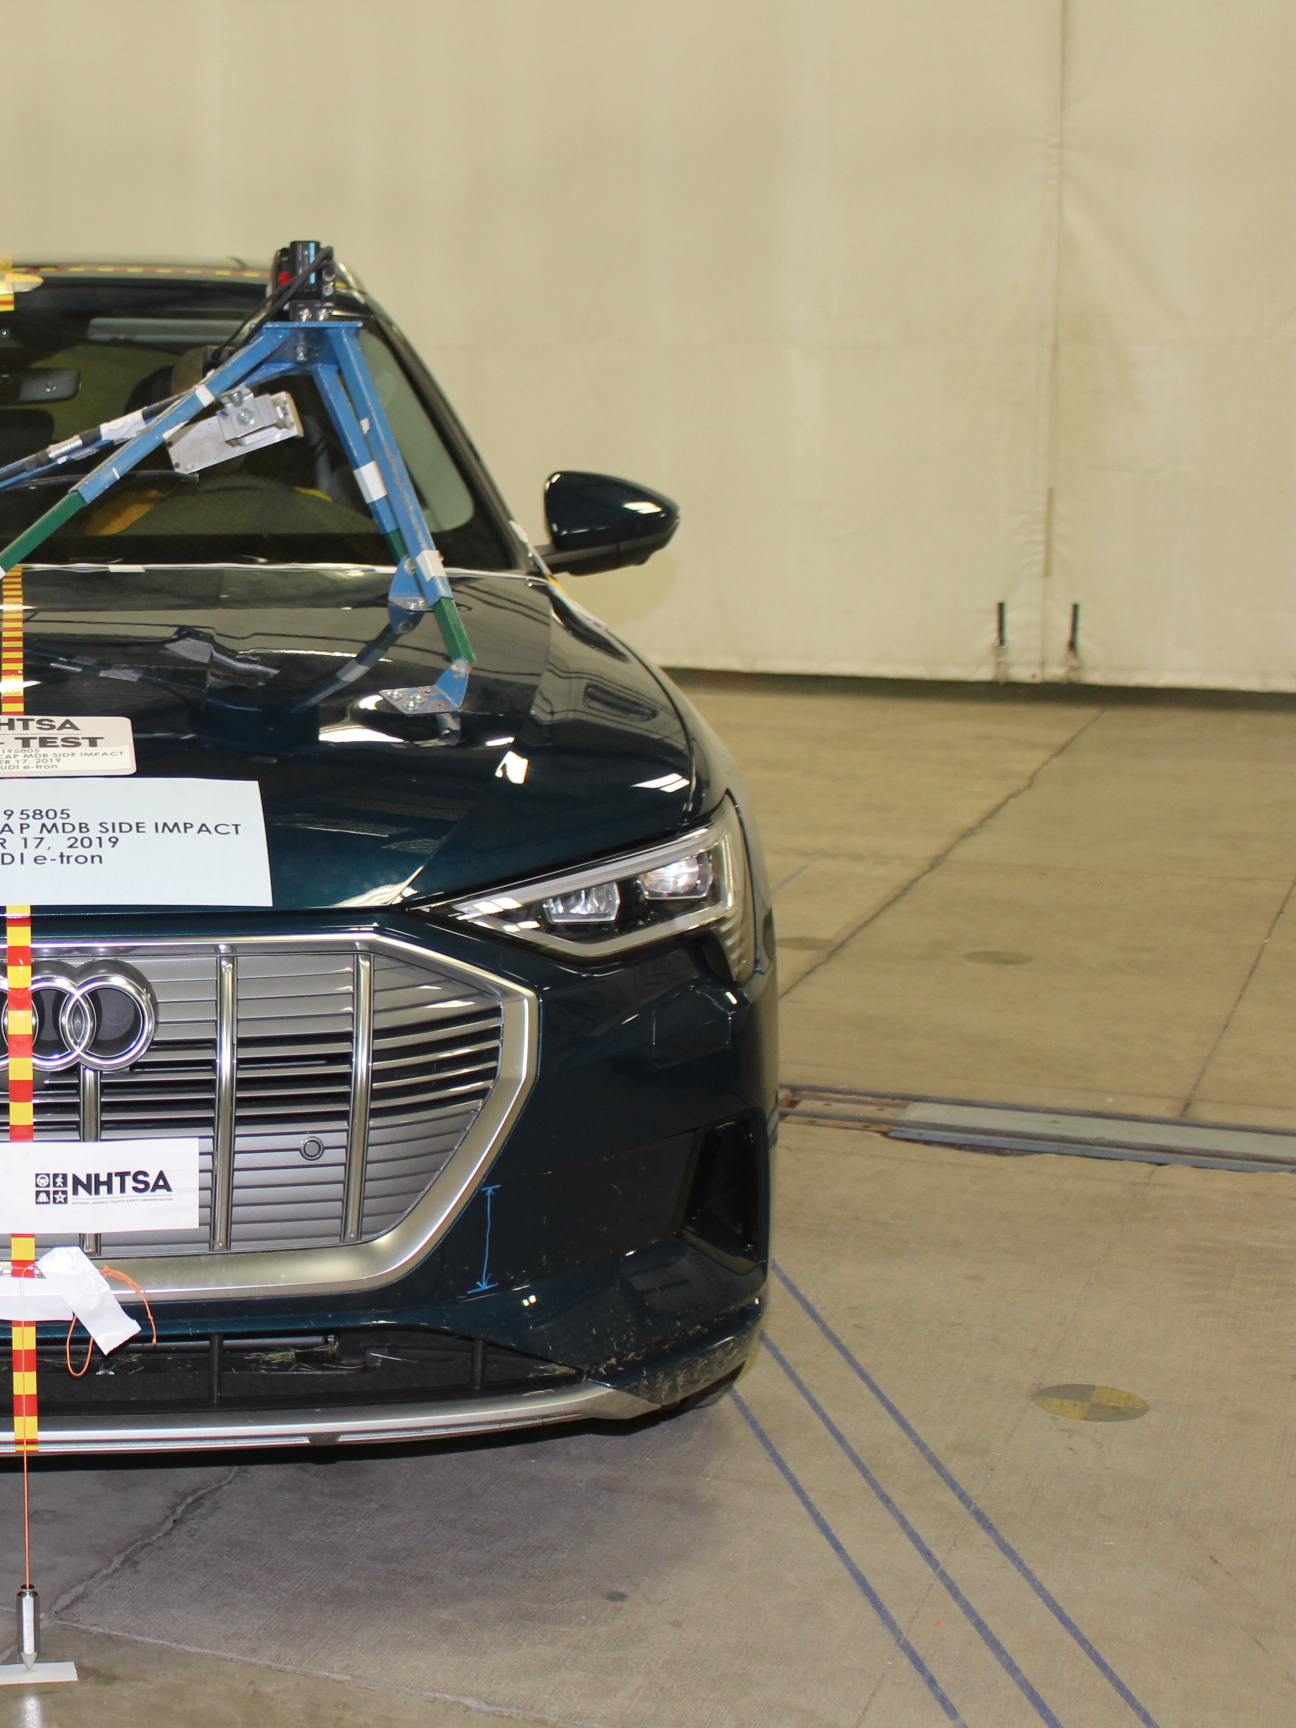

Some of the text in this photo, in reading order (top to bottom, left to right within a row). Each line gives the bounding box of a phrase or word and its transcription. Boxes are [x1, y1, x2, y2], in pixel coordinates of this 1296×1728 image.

[14, 736, 104, 748] TEST
[39, 822, 90, 835] MDB
[98, 821, 146, 834] SIDE
[154, 821, 242, 835] IMPACT
[20, 836, 52, 851] 17,
[66, 836, 120, 849] 2019
[33, 851, 103, 865] e-tron
[72, 1170, 173, 1196] NHTSA
